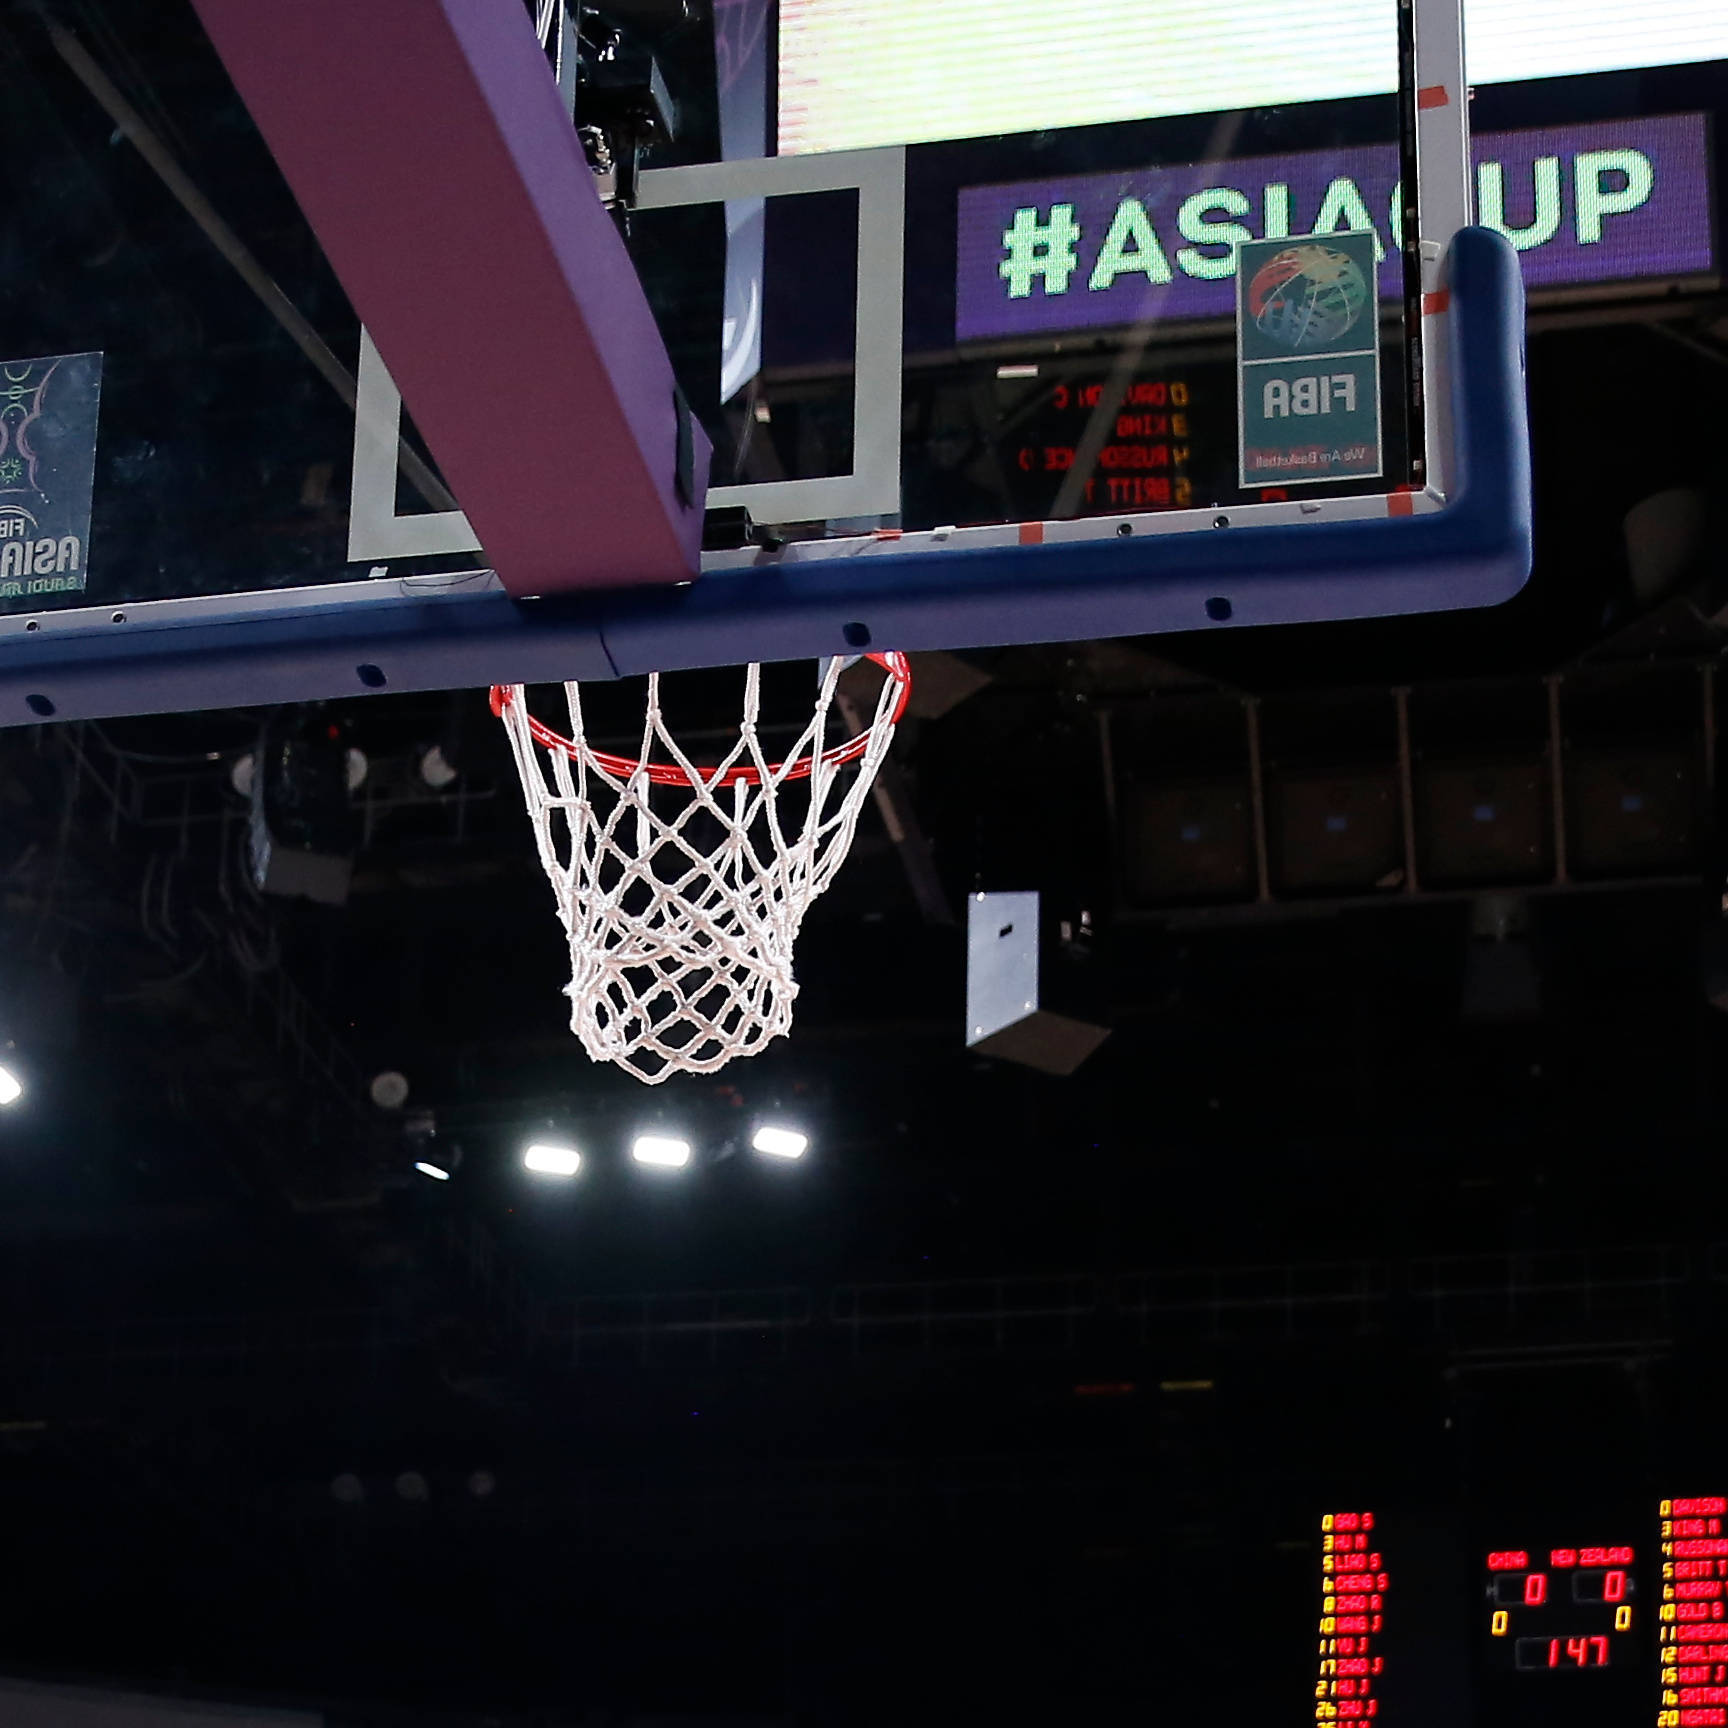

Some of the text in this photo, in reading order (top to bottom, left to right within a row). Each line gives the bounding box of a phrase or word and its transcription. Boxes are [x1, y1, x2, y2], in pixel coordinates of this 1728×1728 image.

[999, 148, 1655, 300] #ASIAUP
[1661, 1521, 1672, 1538] 3
[1323, 1535, 1333, 1552] 3
[1323, 1555, 1333, 1572] 5
[1488, 1551, 1528, 1570] CHINA
[1550, 1547, 1634, 1567] NEW ZEALAND
[1663, 1562, 1673, 1579] 5
[1323, 1577, 1334, 1593] 6
[1524, 1573, 1547, 1606] 0
[1603, 1570, 1627, 1602] 0
[1663, 1584, 1674, 1600] 6
[1615, 1606, 1631, 1632] 0
[1660, 1604, 1676, 1621] 10
[1320, 1617, 1335, 1635] 10
[1492, 1611, 1508, 1636] 0
[1660, 1626, 1676, 1642] 11
[1320, 1639, 1336, 1655] 11
[1661, 1646, 1677, 1664] 12
[1320, 1659, 1336, 1676] 17
[1662, 1667, 1677, 1685] 15
[1316, 1681, 1336, 1698] 21
[1662, 1688, 1678, 1706] 16
[1316, 1701, 1337, 1718] 26
[1658, 1710, 1679, 1728] 20
